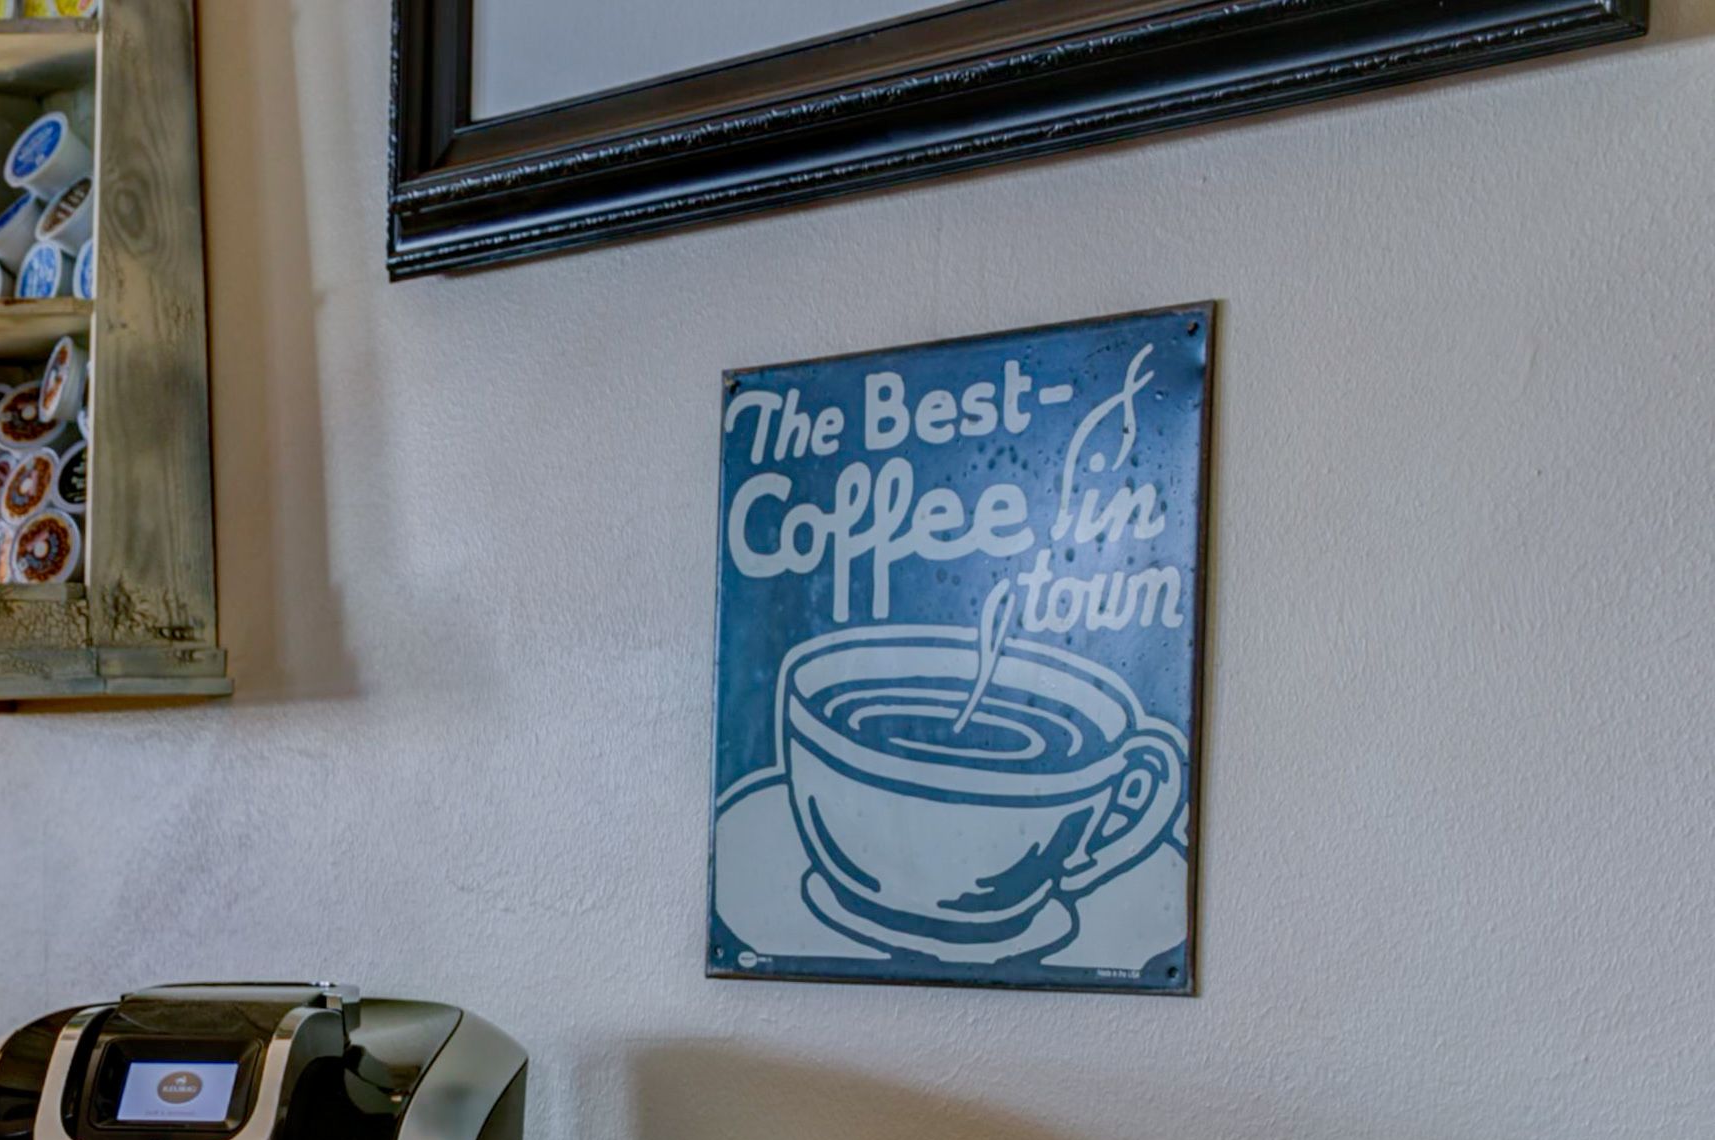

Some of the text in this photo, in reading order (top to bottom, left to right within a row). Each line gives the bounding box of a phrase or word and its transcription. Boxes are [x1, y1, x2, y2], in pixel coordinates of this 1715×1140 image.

[724, 388, 845, 464] The
[728, 452, 1166, 623] Coffee in
[1017, 548, 1183, 634] town
